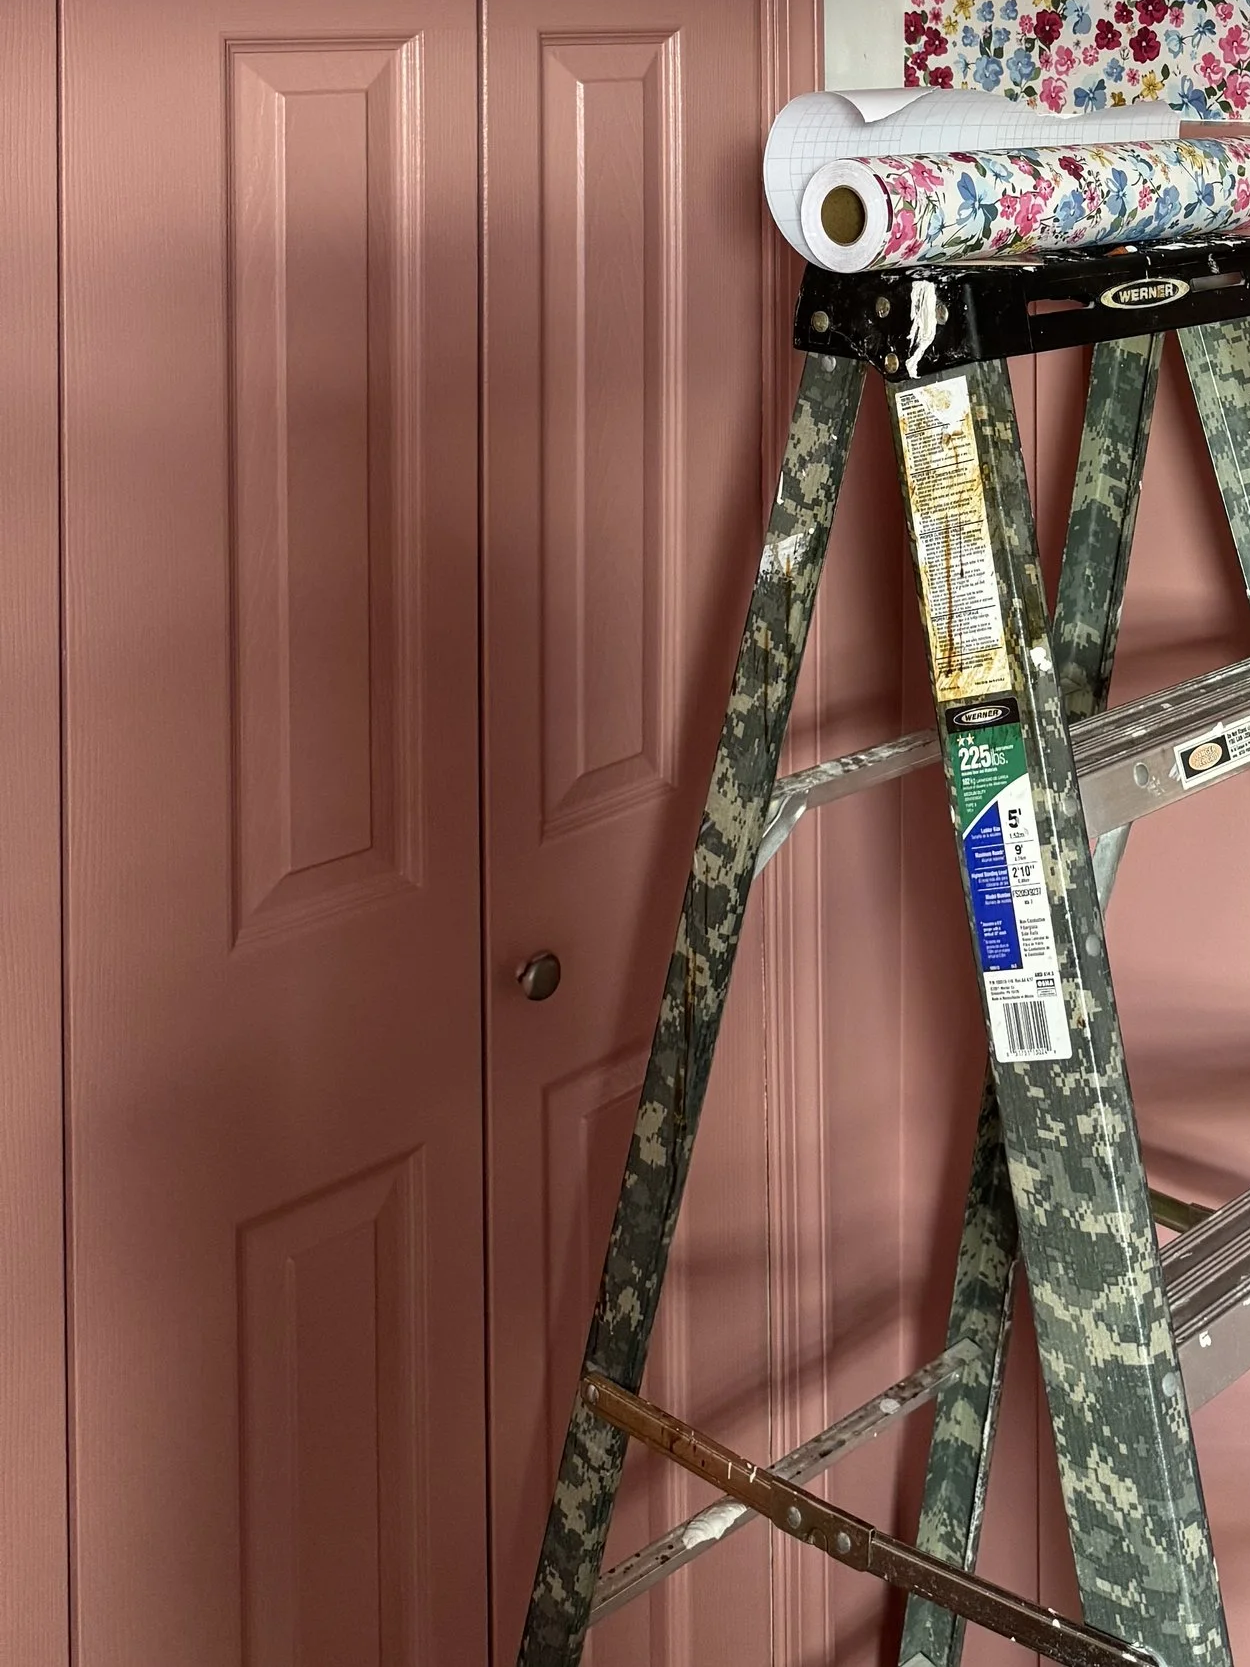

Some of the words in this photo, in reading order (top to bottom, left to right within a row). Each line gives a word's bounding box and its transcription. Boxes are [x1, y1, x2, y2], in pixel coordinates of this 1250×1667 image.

[1118, 283, 1174, 304] WERNER
[964, 709, 999, 722] WERNER
[1008, 808, 1022, 829] 5'
